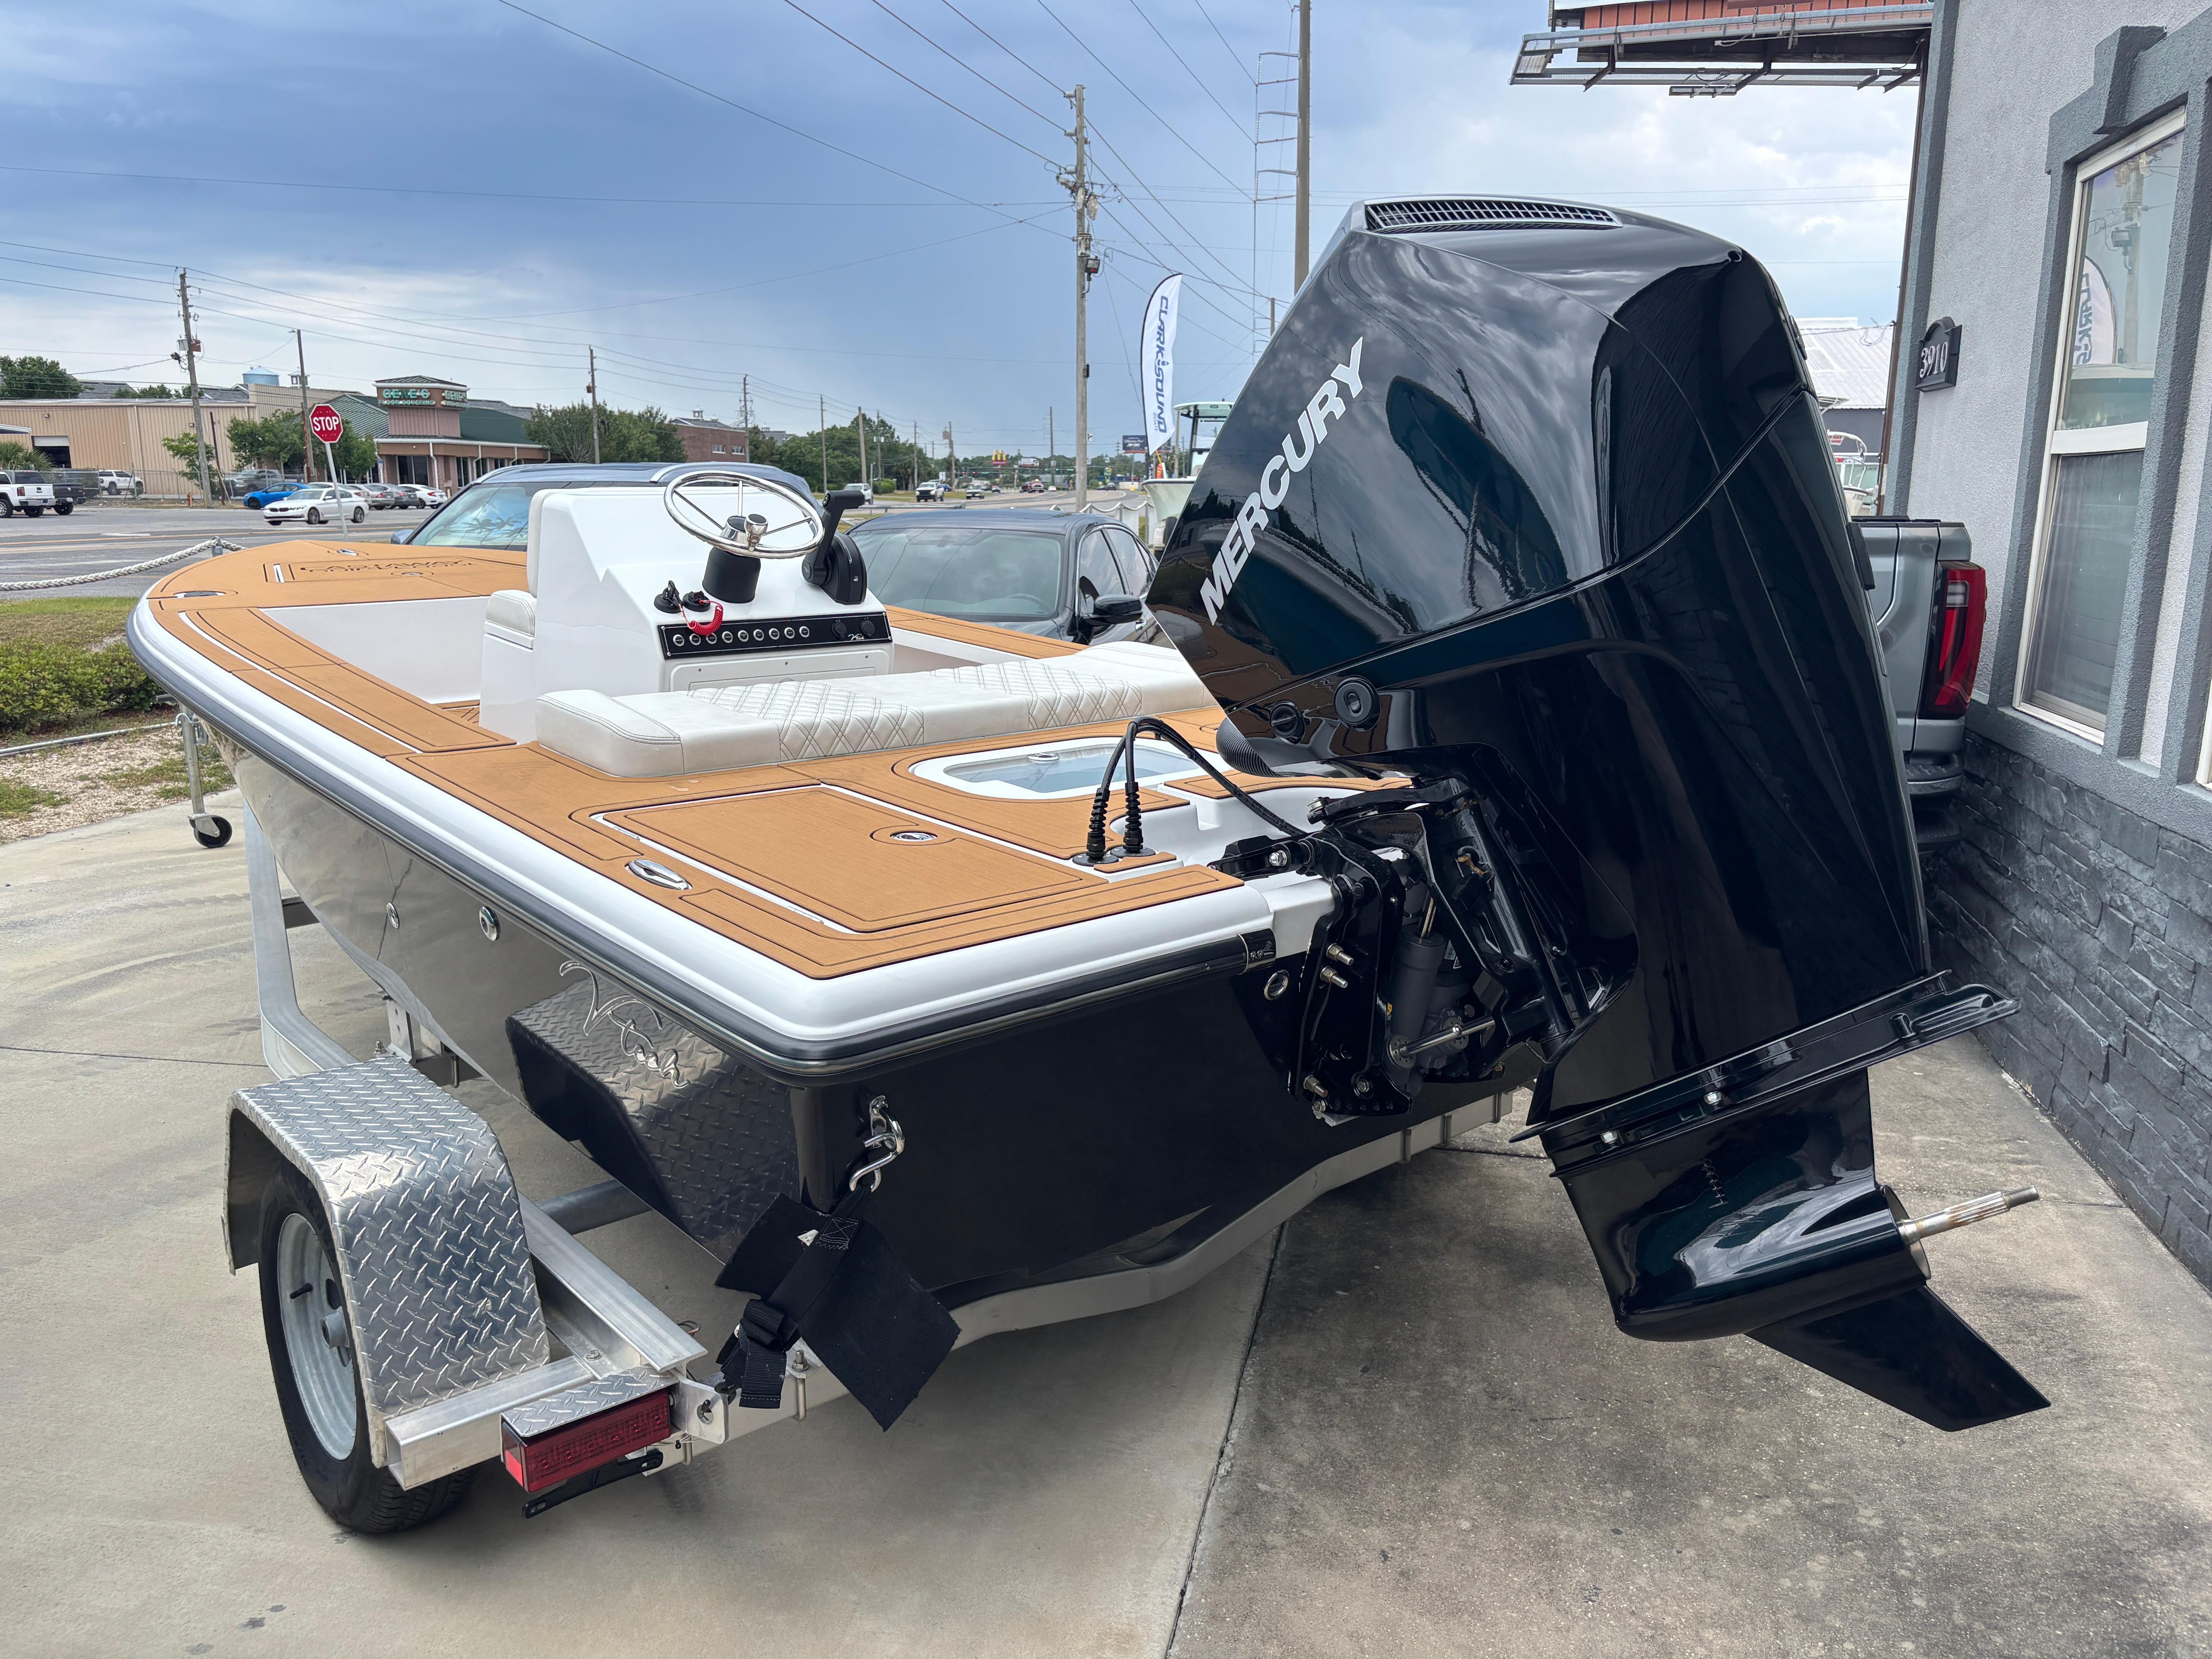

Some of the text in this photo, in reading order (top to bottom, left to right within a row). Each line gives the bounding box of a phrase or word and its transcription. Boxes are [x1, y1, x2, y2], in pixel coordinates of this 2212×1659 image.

[1920, 342, 1949, 378] 3910
[383, 389, 430, 398] GENE'S
[313, 416, 339, 431] STOP
[1200, 336, 1363, 626] MERCURY
